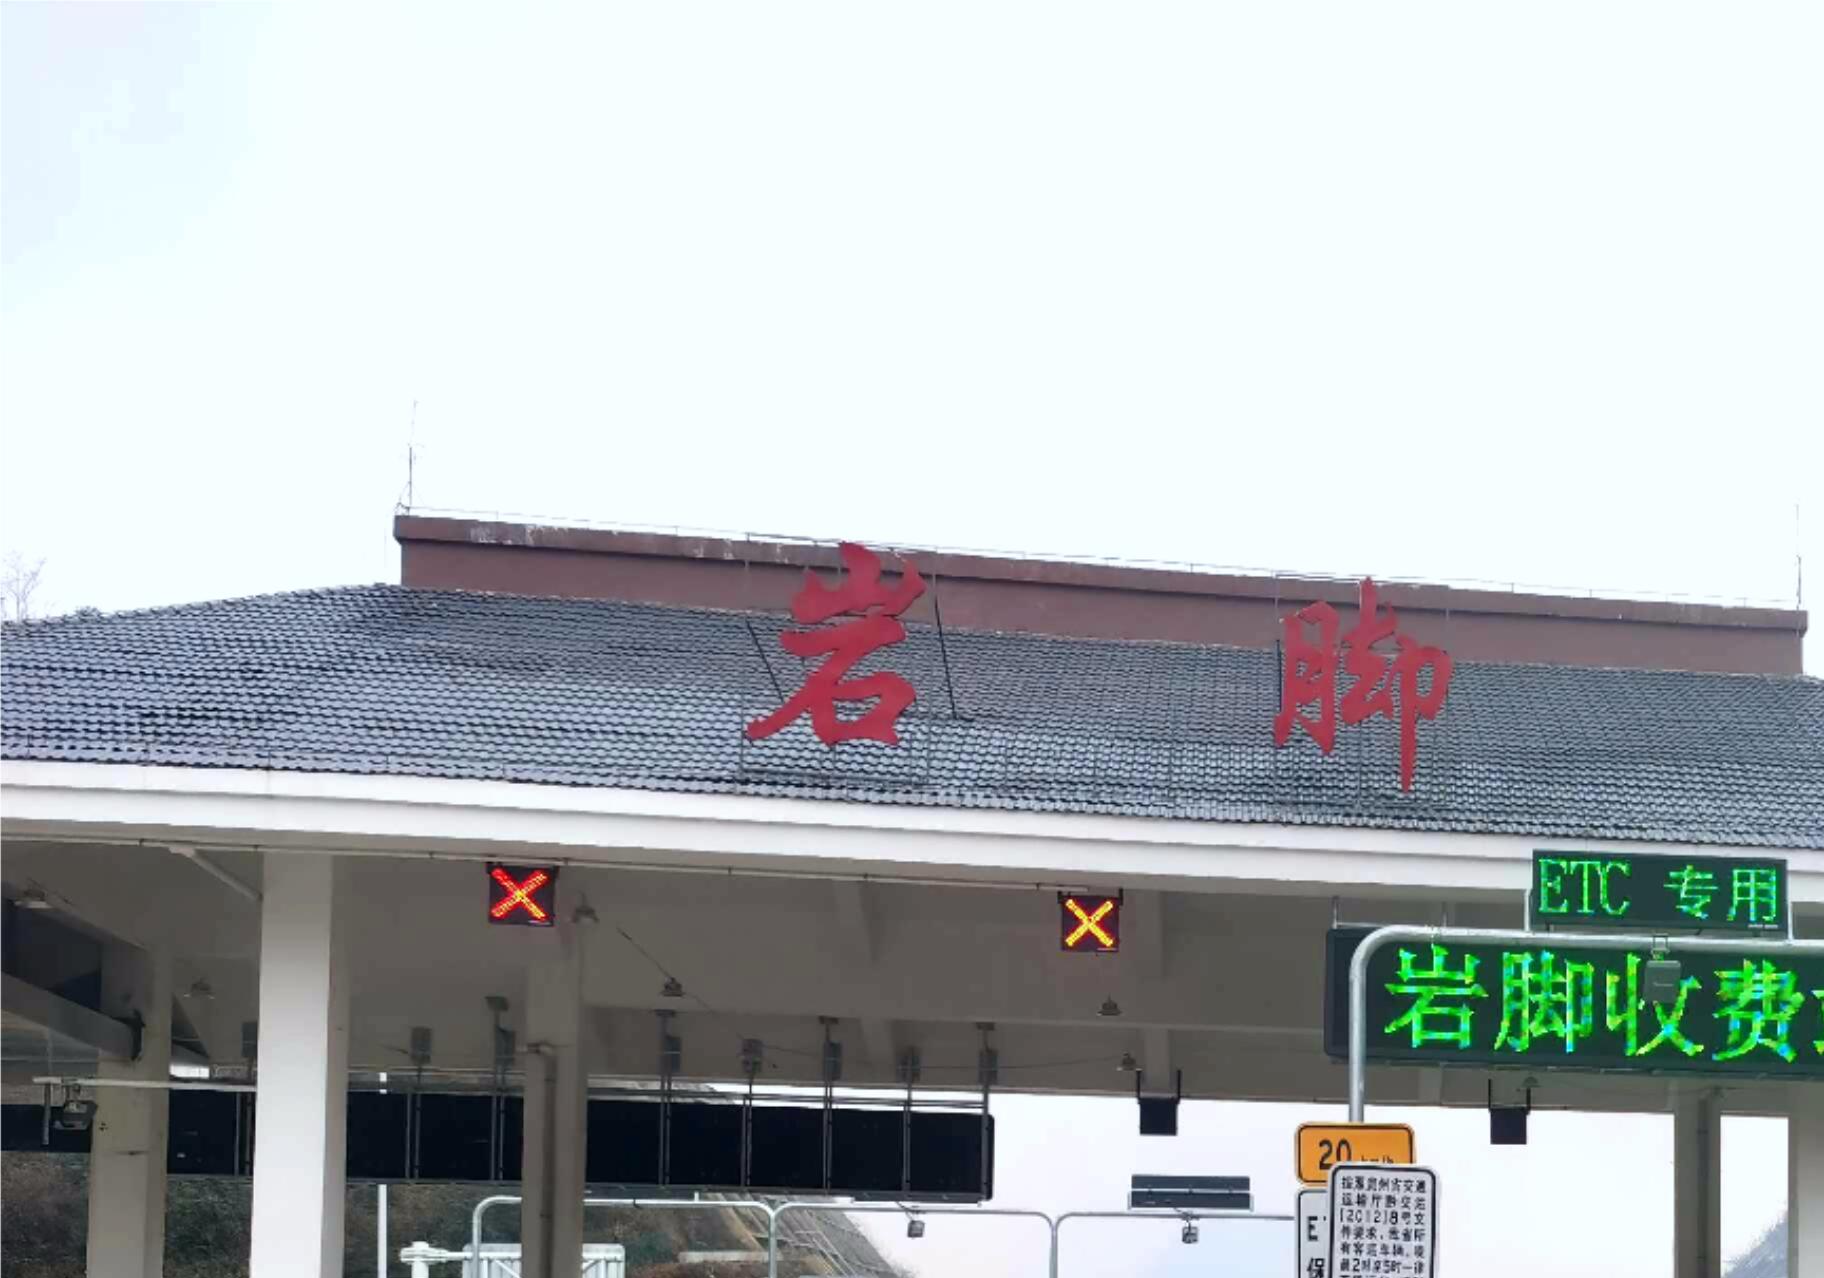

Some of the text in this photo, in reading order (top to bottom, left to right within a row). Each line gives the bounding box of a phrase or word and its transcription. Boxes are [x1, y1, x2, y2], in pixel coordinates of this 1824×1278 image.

[746, 541, 1452, 794] 岩脚
[1539, 858, 1778, 923] ETC 专用
[1318, 1138, 1352, 1170] 20
